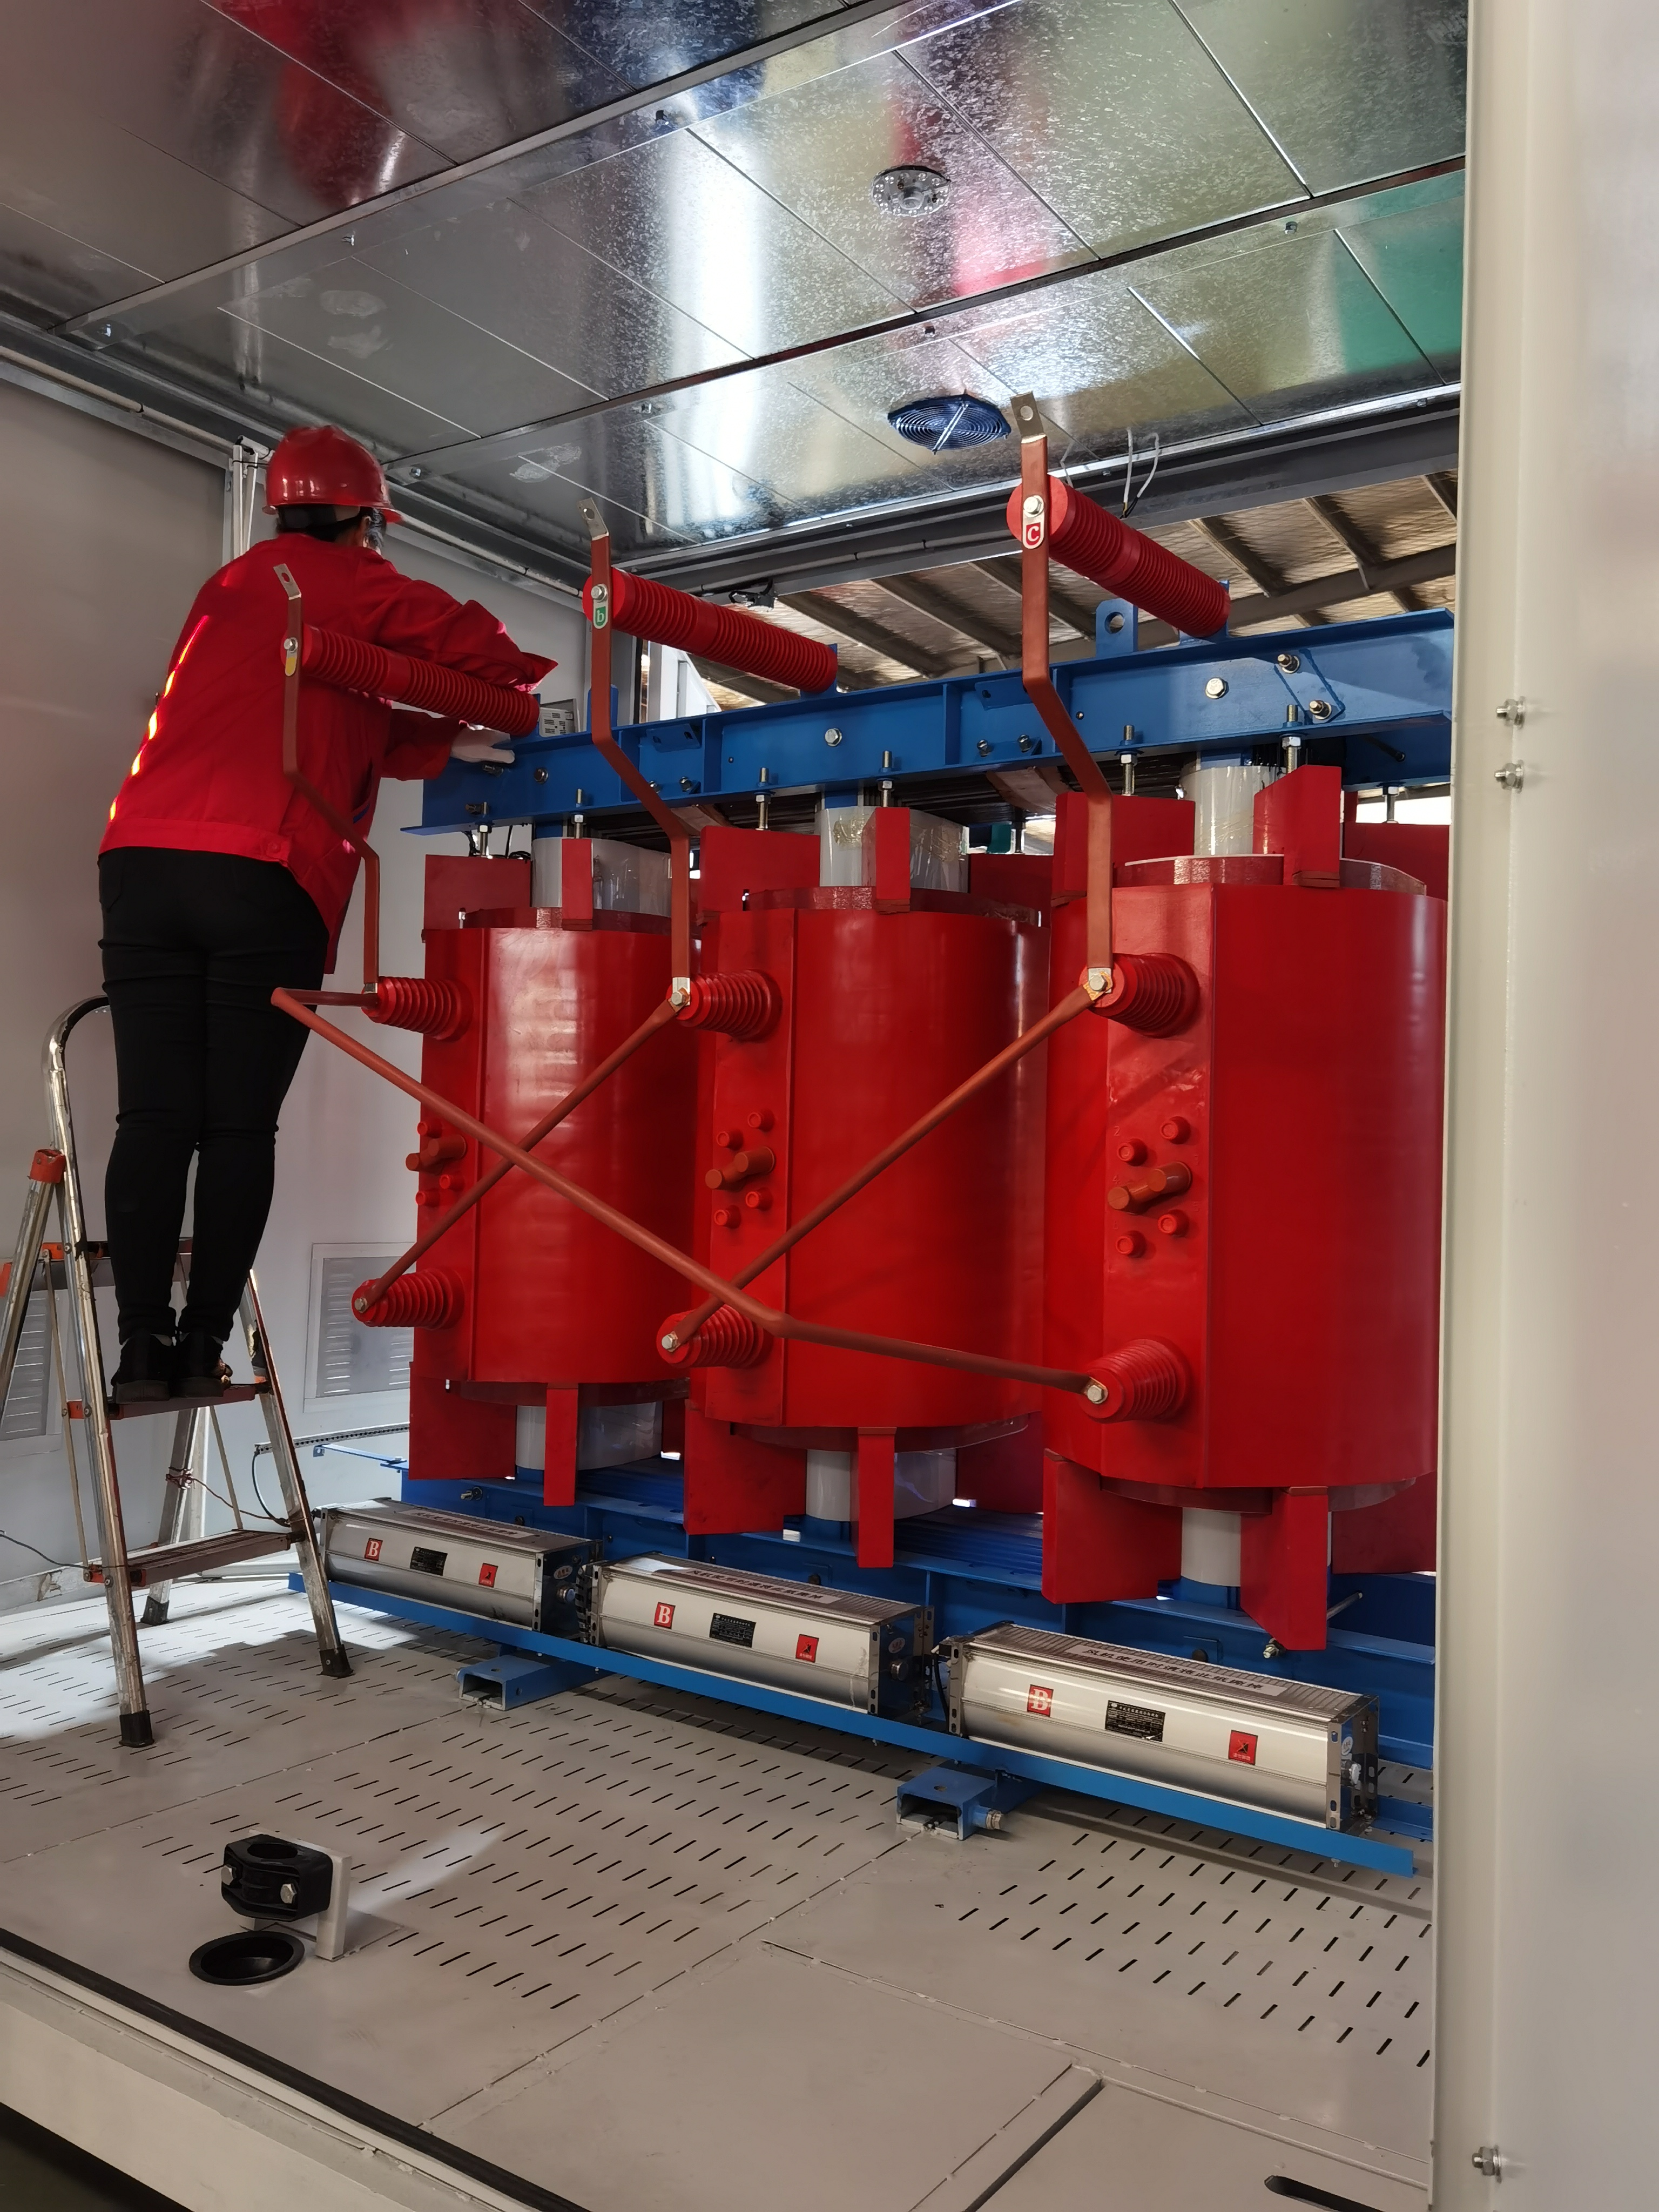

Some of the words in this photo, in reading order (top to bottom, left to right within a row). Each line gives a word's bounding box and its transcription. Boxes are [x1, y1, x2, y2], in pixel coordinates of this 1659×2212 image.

[1114, 1125, 1120, 1136] 2
[1112, 1175, 1120, 1185] 4
[1192, 1202, 1200, 1212] 5
[367, 1541, 379, 1557] B
[657, 1605, 671, 1624] B
[1030, 1688, 1048, 1711] B
